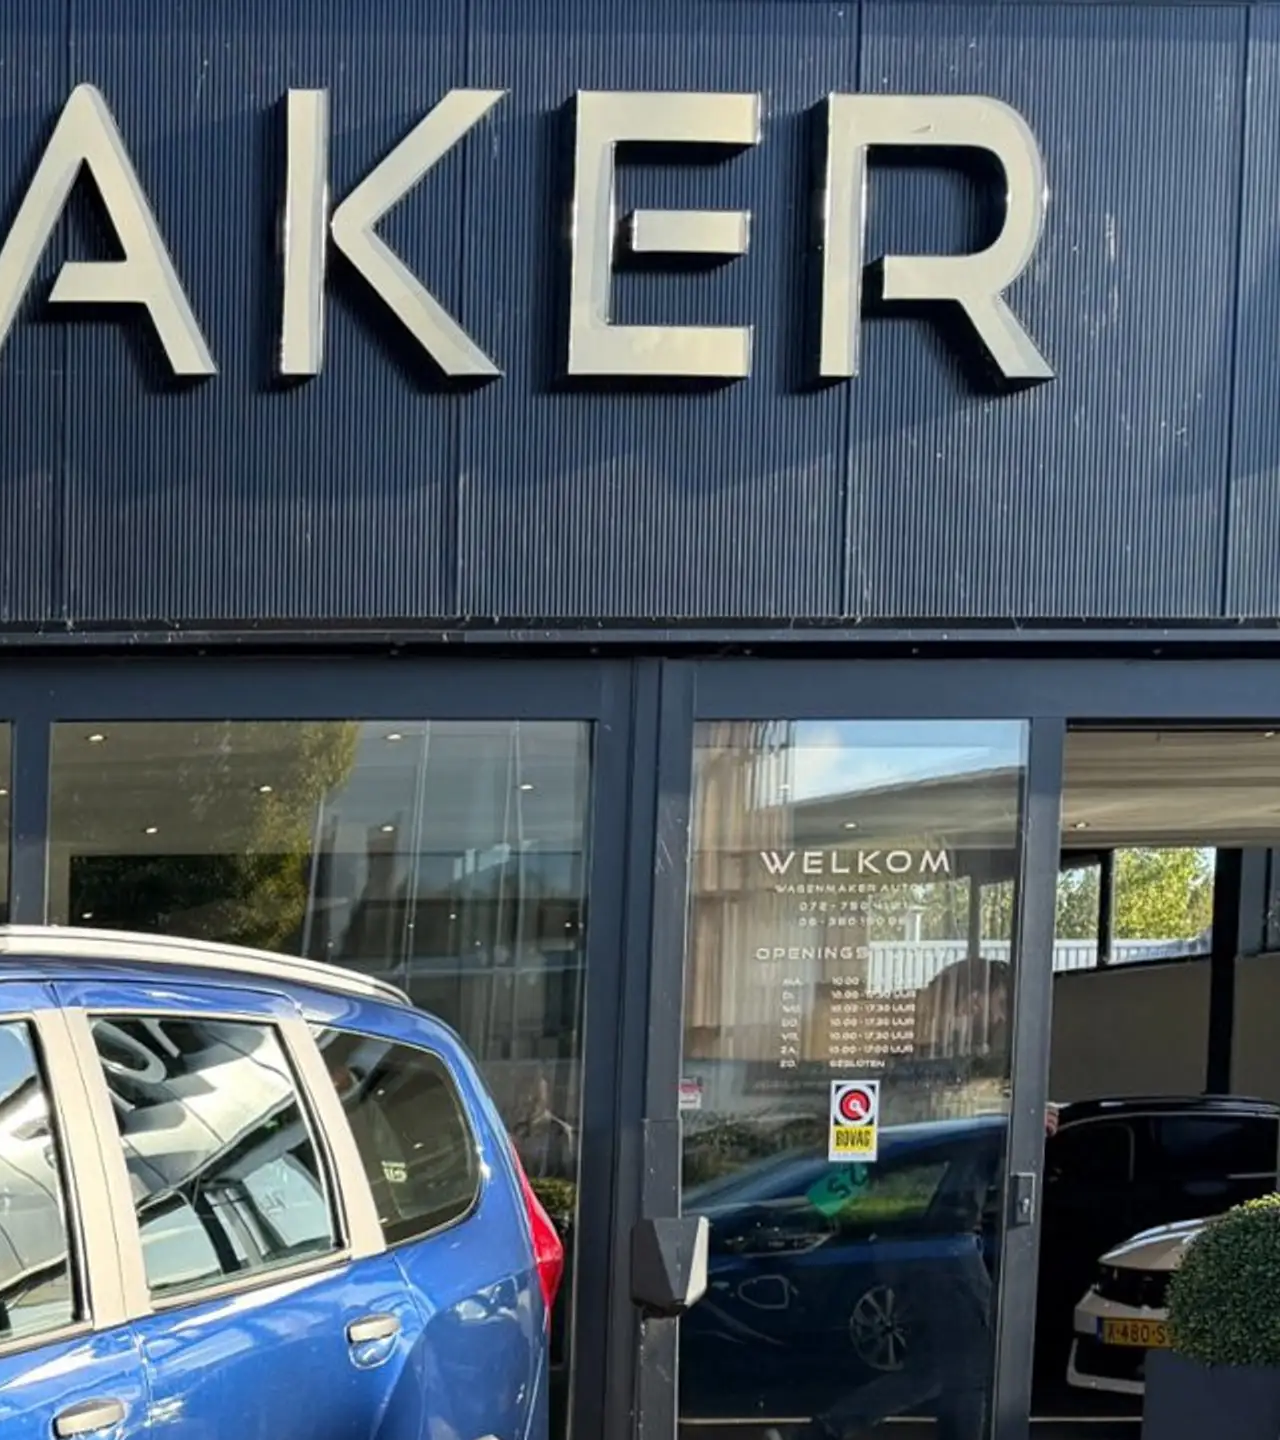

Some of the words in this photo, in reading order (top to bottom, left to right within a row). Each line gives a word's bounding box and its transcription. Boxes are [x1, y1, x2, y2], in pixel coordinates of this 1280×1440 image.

[760, 850, 951, 875] WELKOM
[775, 883, 876, 894] WAGENMAKER
[835, 1128, 871, 1147] BOVAG
[1108, 1322, 1167, 1344] X-480-S
